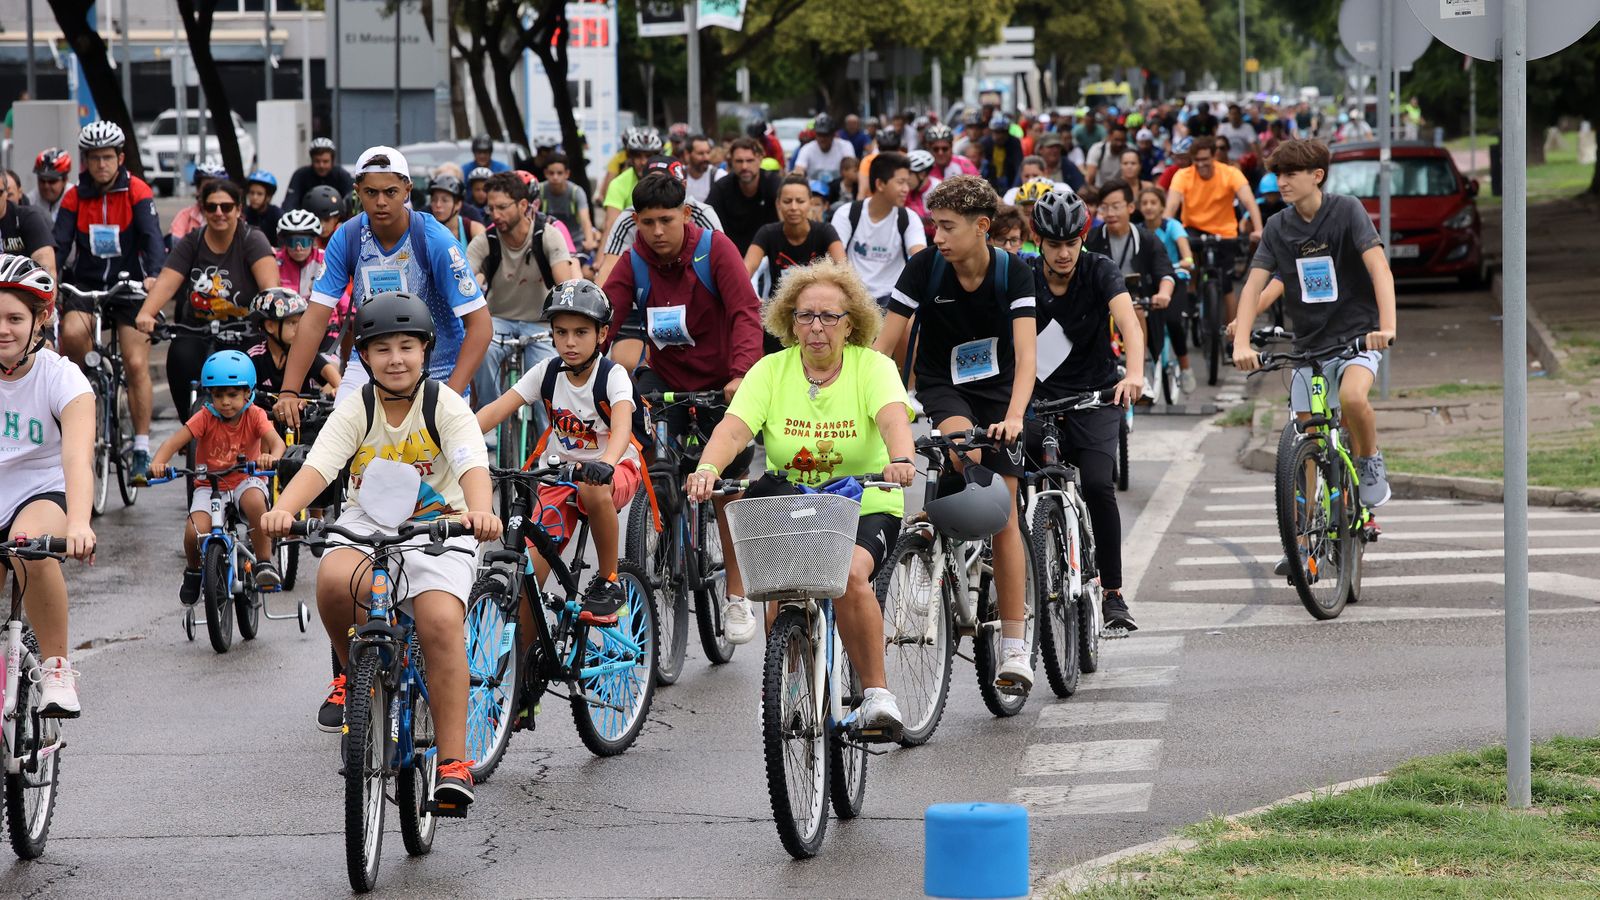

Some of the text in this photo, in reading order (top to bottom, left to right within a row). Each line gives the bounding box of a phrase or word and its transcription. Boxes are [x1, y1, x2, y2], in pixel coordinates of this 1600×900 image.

[785, 418, 855, 430] DONA SANGRE
[784, 427, 857, 438] DONA MEDULA
